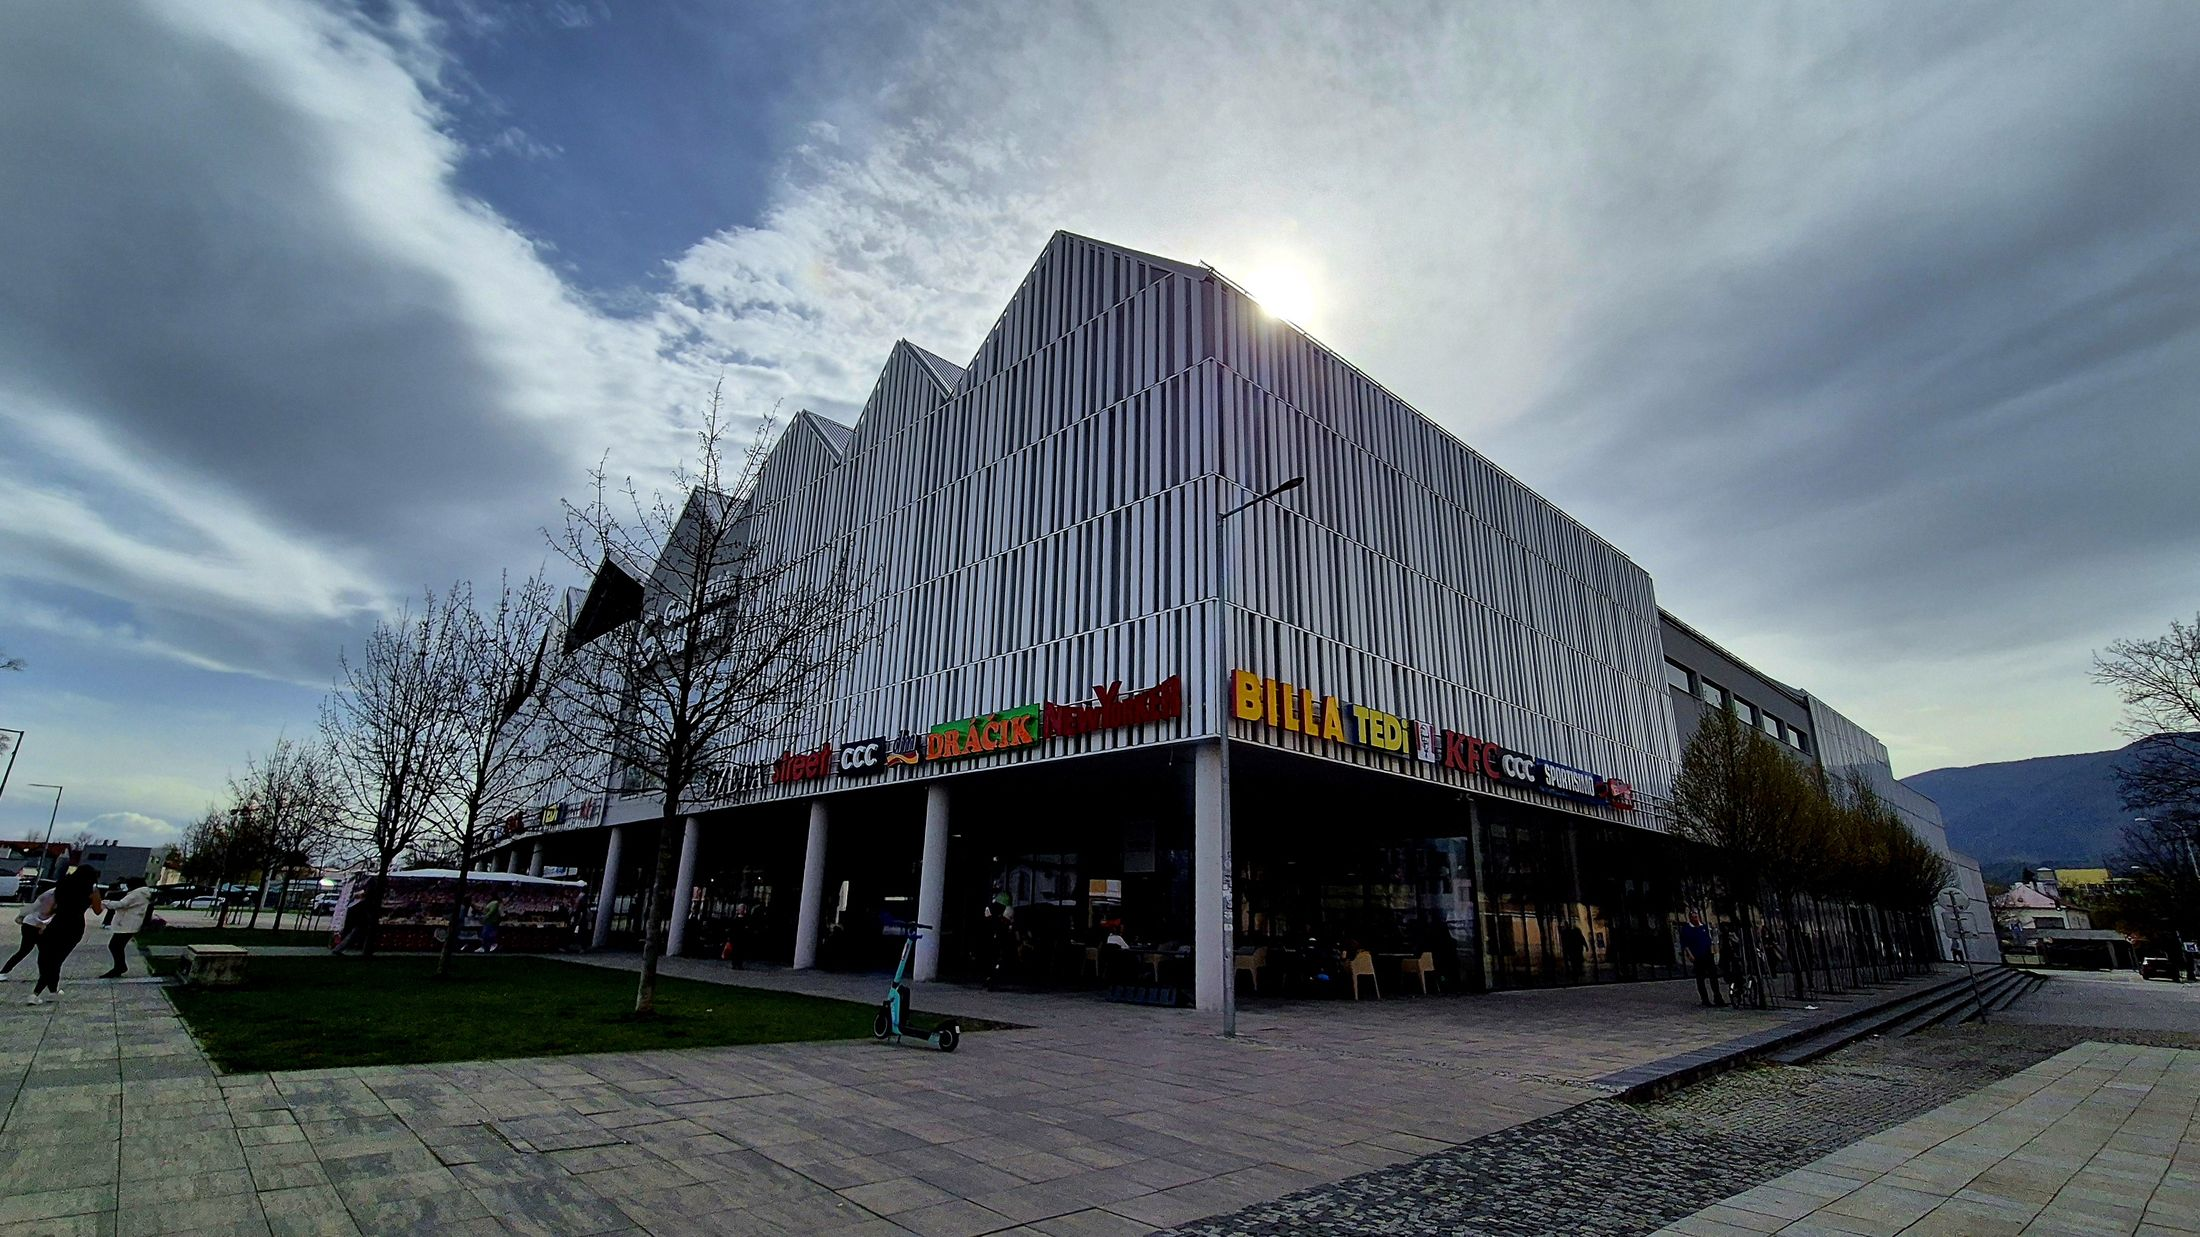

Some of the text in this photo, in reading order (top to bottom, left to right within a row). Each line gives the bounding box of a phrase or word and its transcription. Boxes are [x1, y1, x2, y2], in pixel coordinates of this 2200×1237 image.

[1231, 669, 1345, 743] BILLA
[893, 730, 917, 753] dm
[926, 713, 1033, 761] DRÁČIK
[1353, 704, 1410, 754] TEDi
[772, 742, 832, 784] street
[841, 743, 878, 770] CCC
[1444, 729, 1502, 780] KFC
[1502, 754, 1535, 782] CCC
